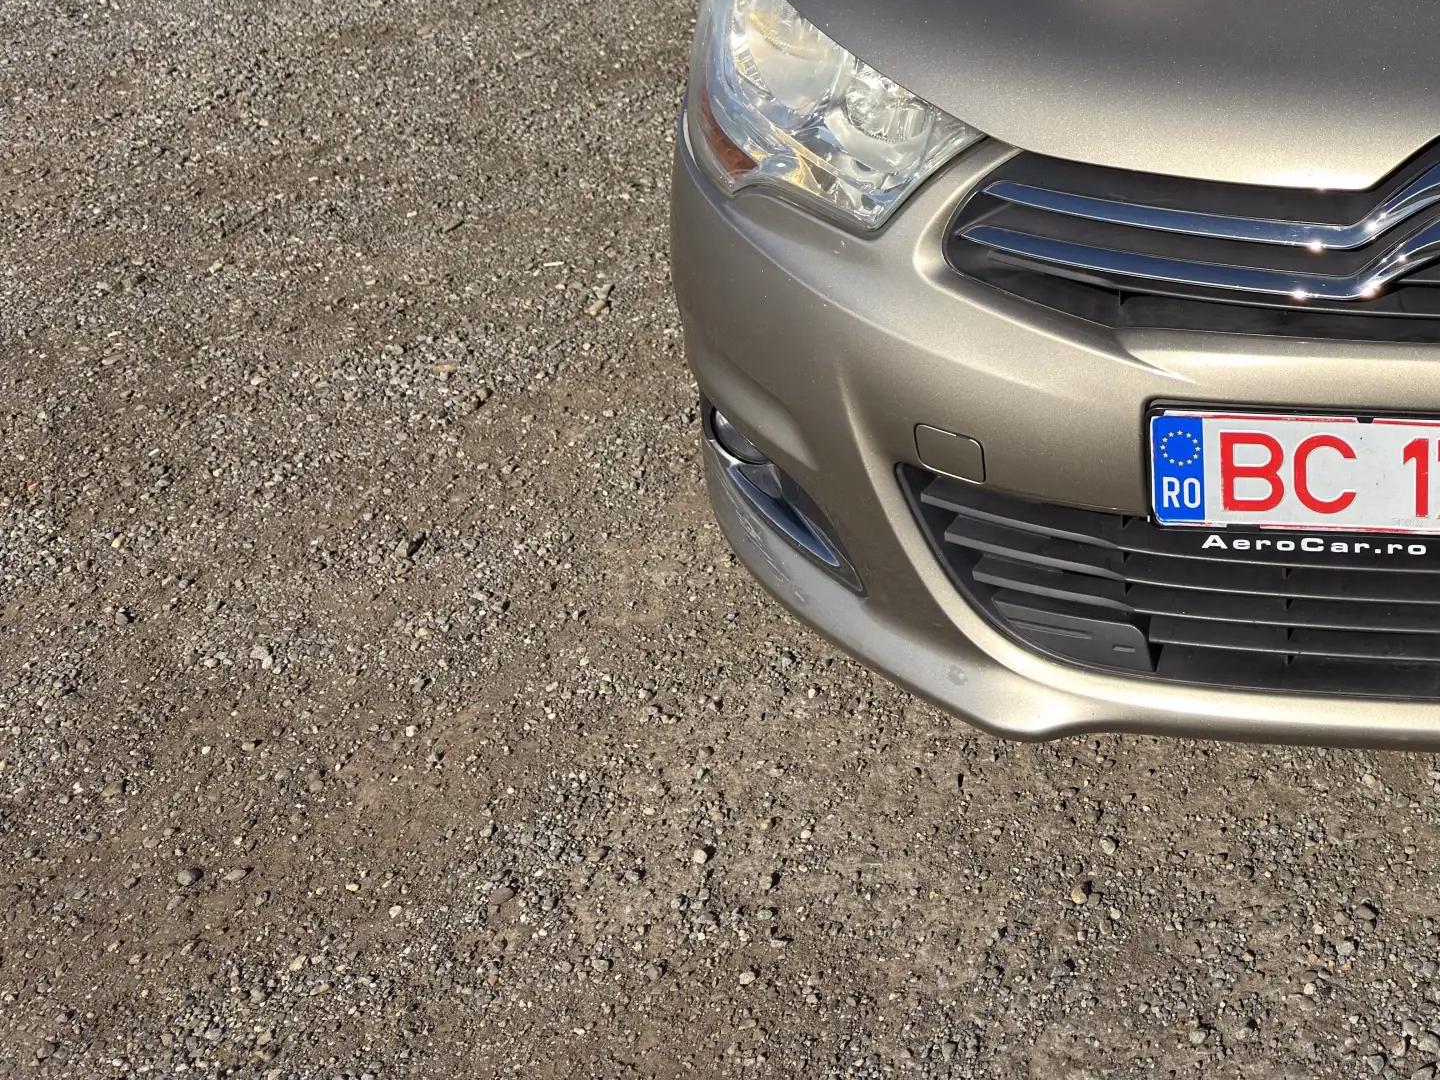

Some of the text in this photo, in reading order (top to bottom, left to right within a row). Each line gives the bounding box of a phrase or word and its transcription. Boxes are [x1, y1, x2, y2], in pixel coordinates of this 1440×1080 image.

[1219, 431, 1357, 515] BC
[1162, 476, 1201, 509] RO
[1201, 533, 1428, 556] AeroCar.ro
